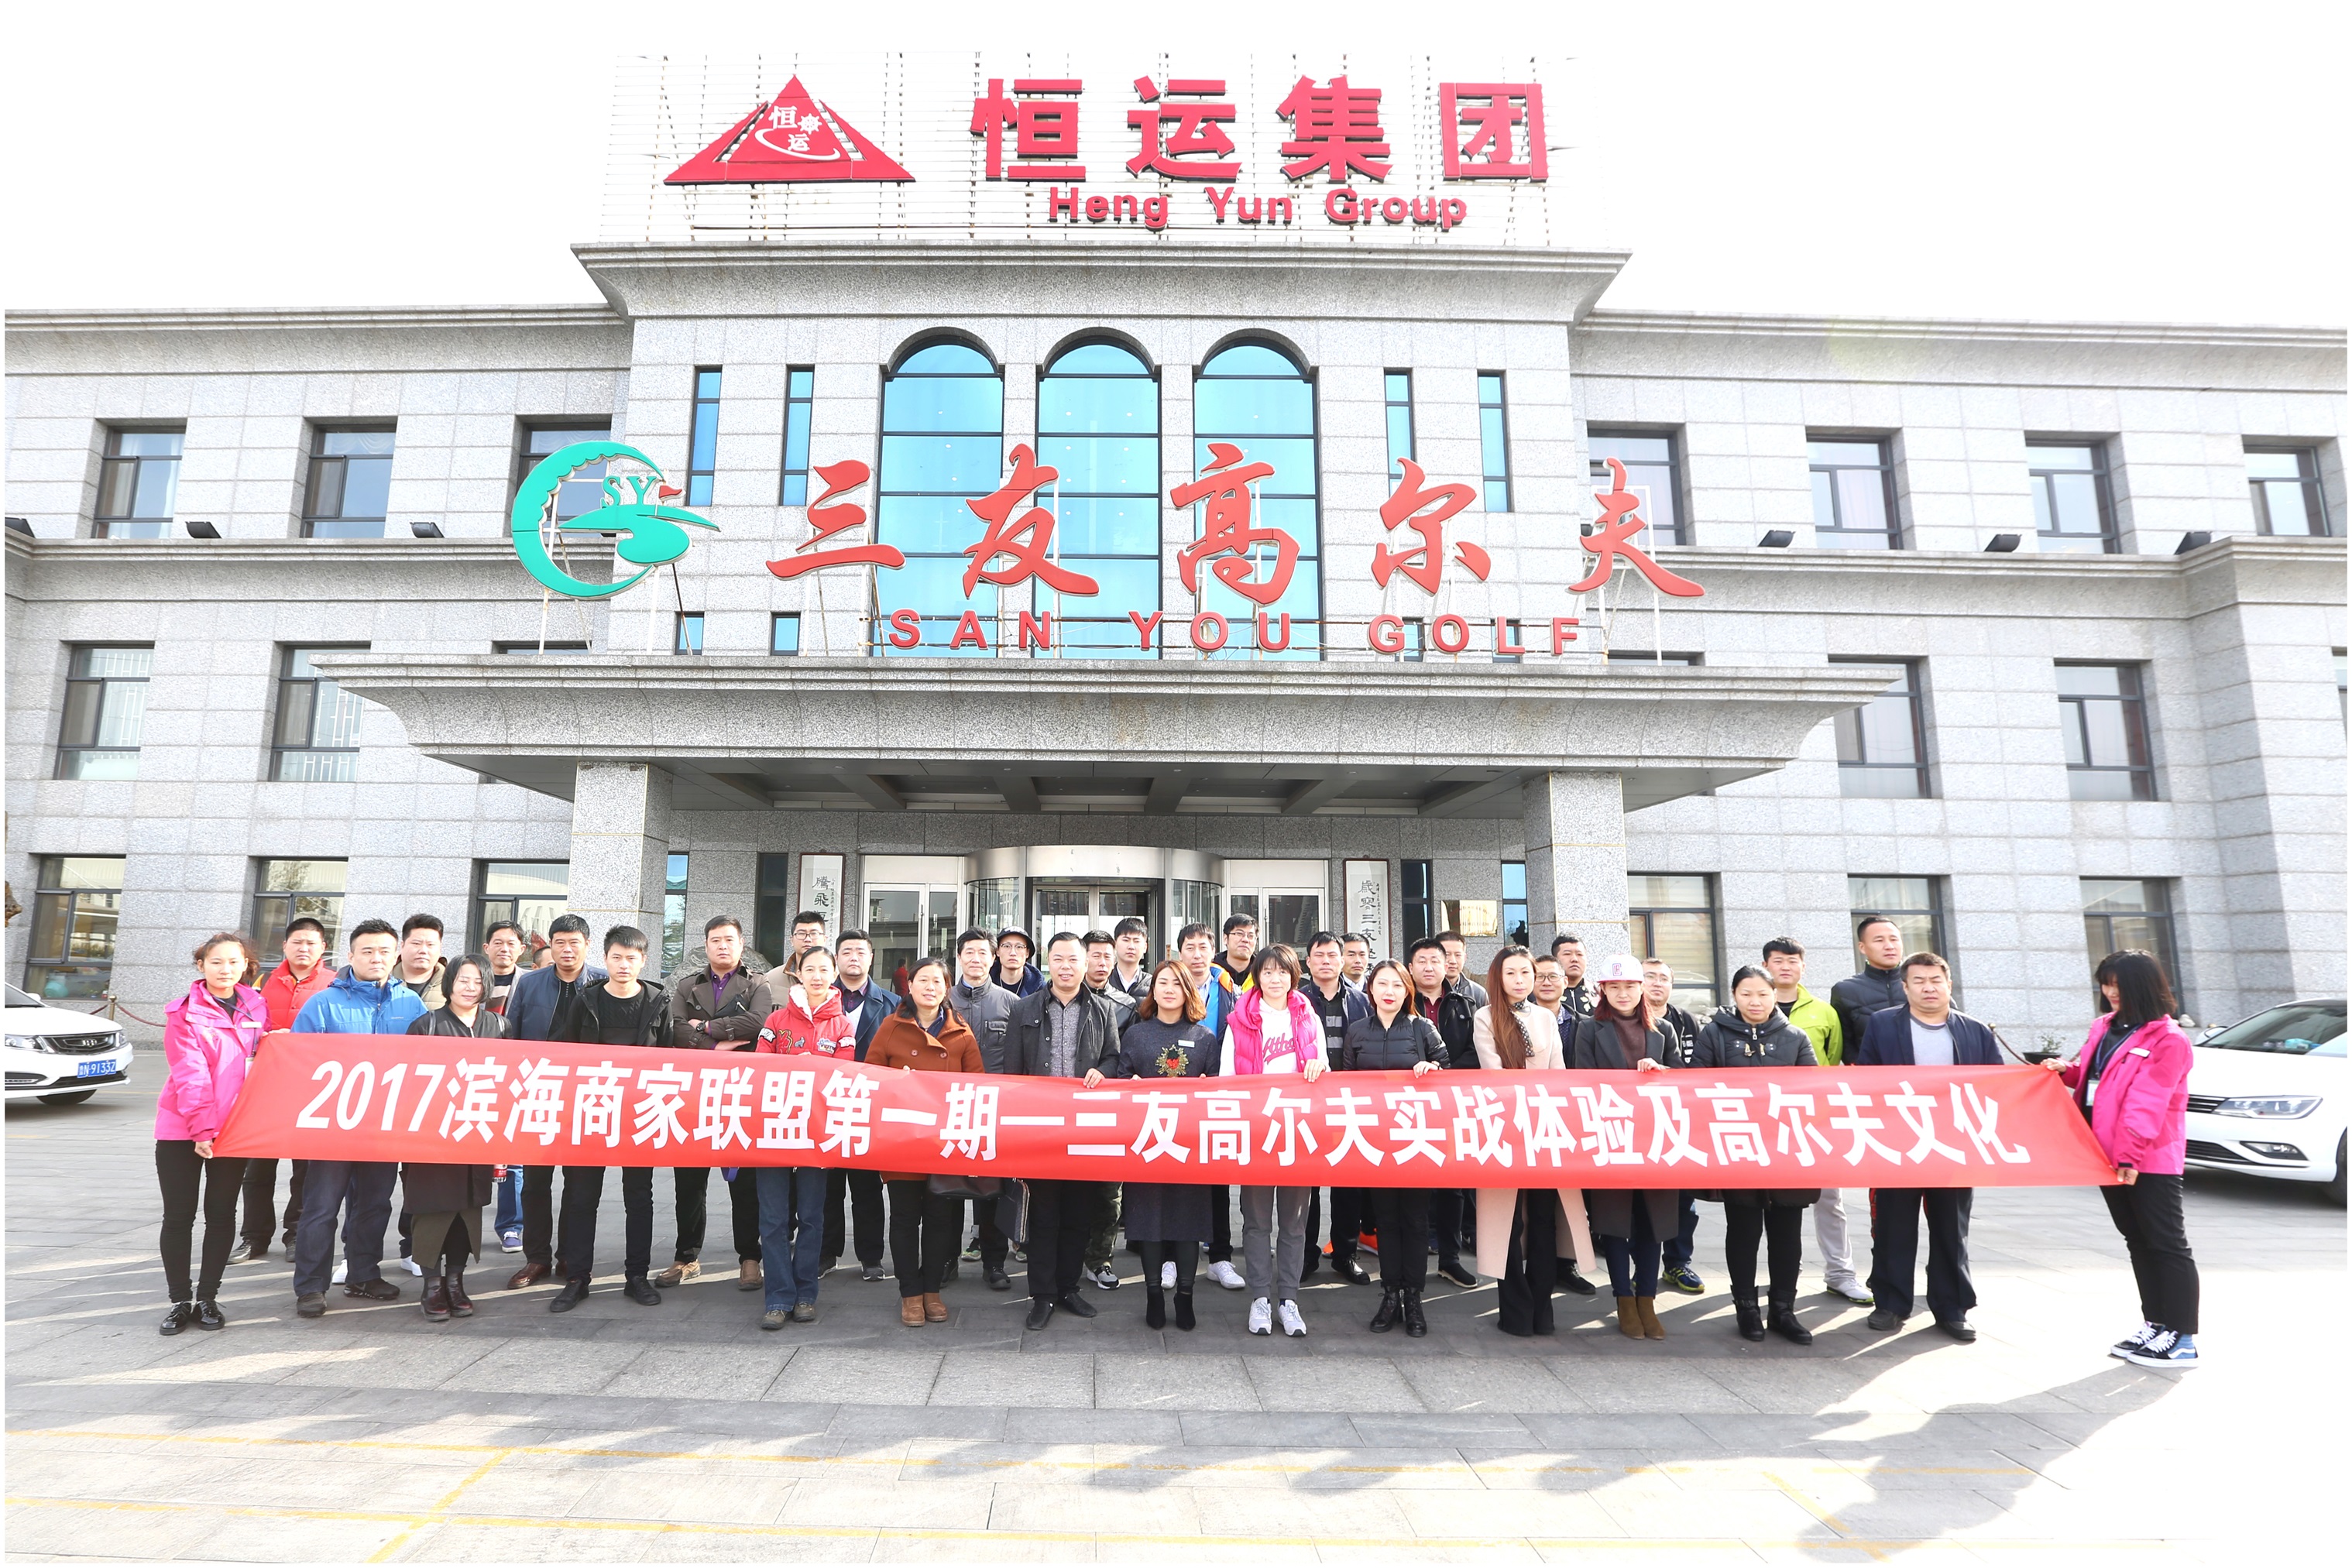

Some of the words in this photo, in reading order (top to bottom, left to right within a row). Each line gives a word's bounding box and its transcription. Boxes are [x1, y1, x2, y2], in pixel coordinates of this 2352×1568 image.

[970, 75, 1549, 183] 恒运集团
[1049, 187, 1169, 231] Heng
[1205, 187, 1293, 225] Yun
[1324, 187, 1468, 232] Group
[600, 475, 657, 508] SY
[766, 443, 1705, 607] 三友高尔夫
[889, 609, 1051, 650] SAN
[1128, 611, 1291, 653] YOU
[1368, 614, 1580, 657] GOLF
